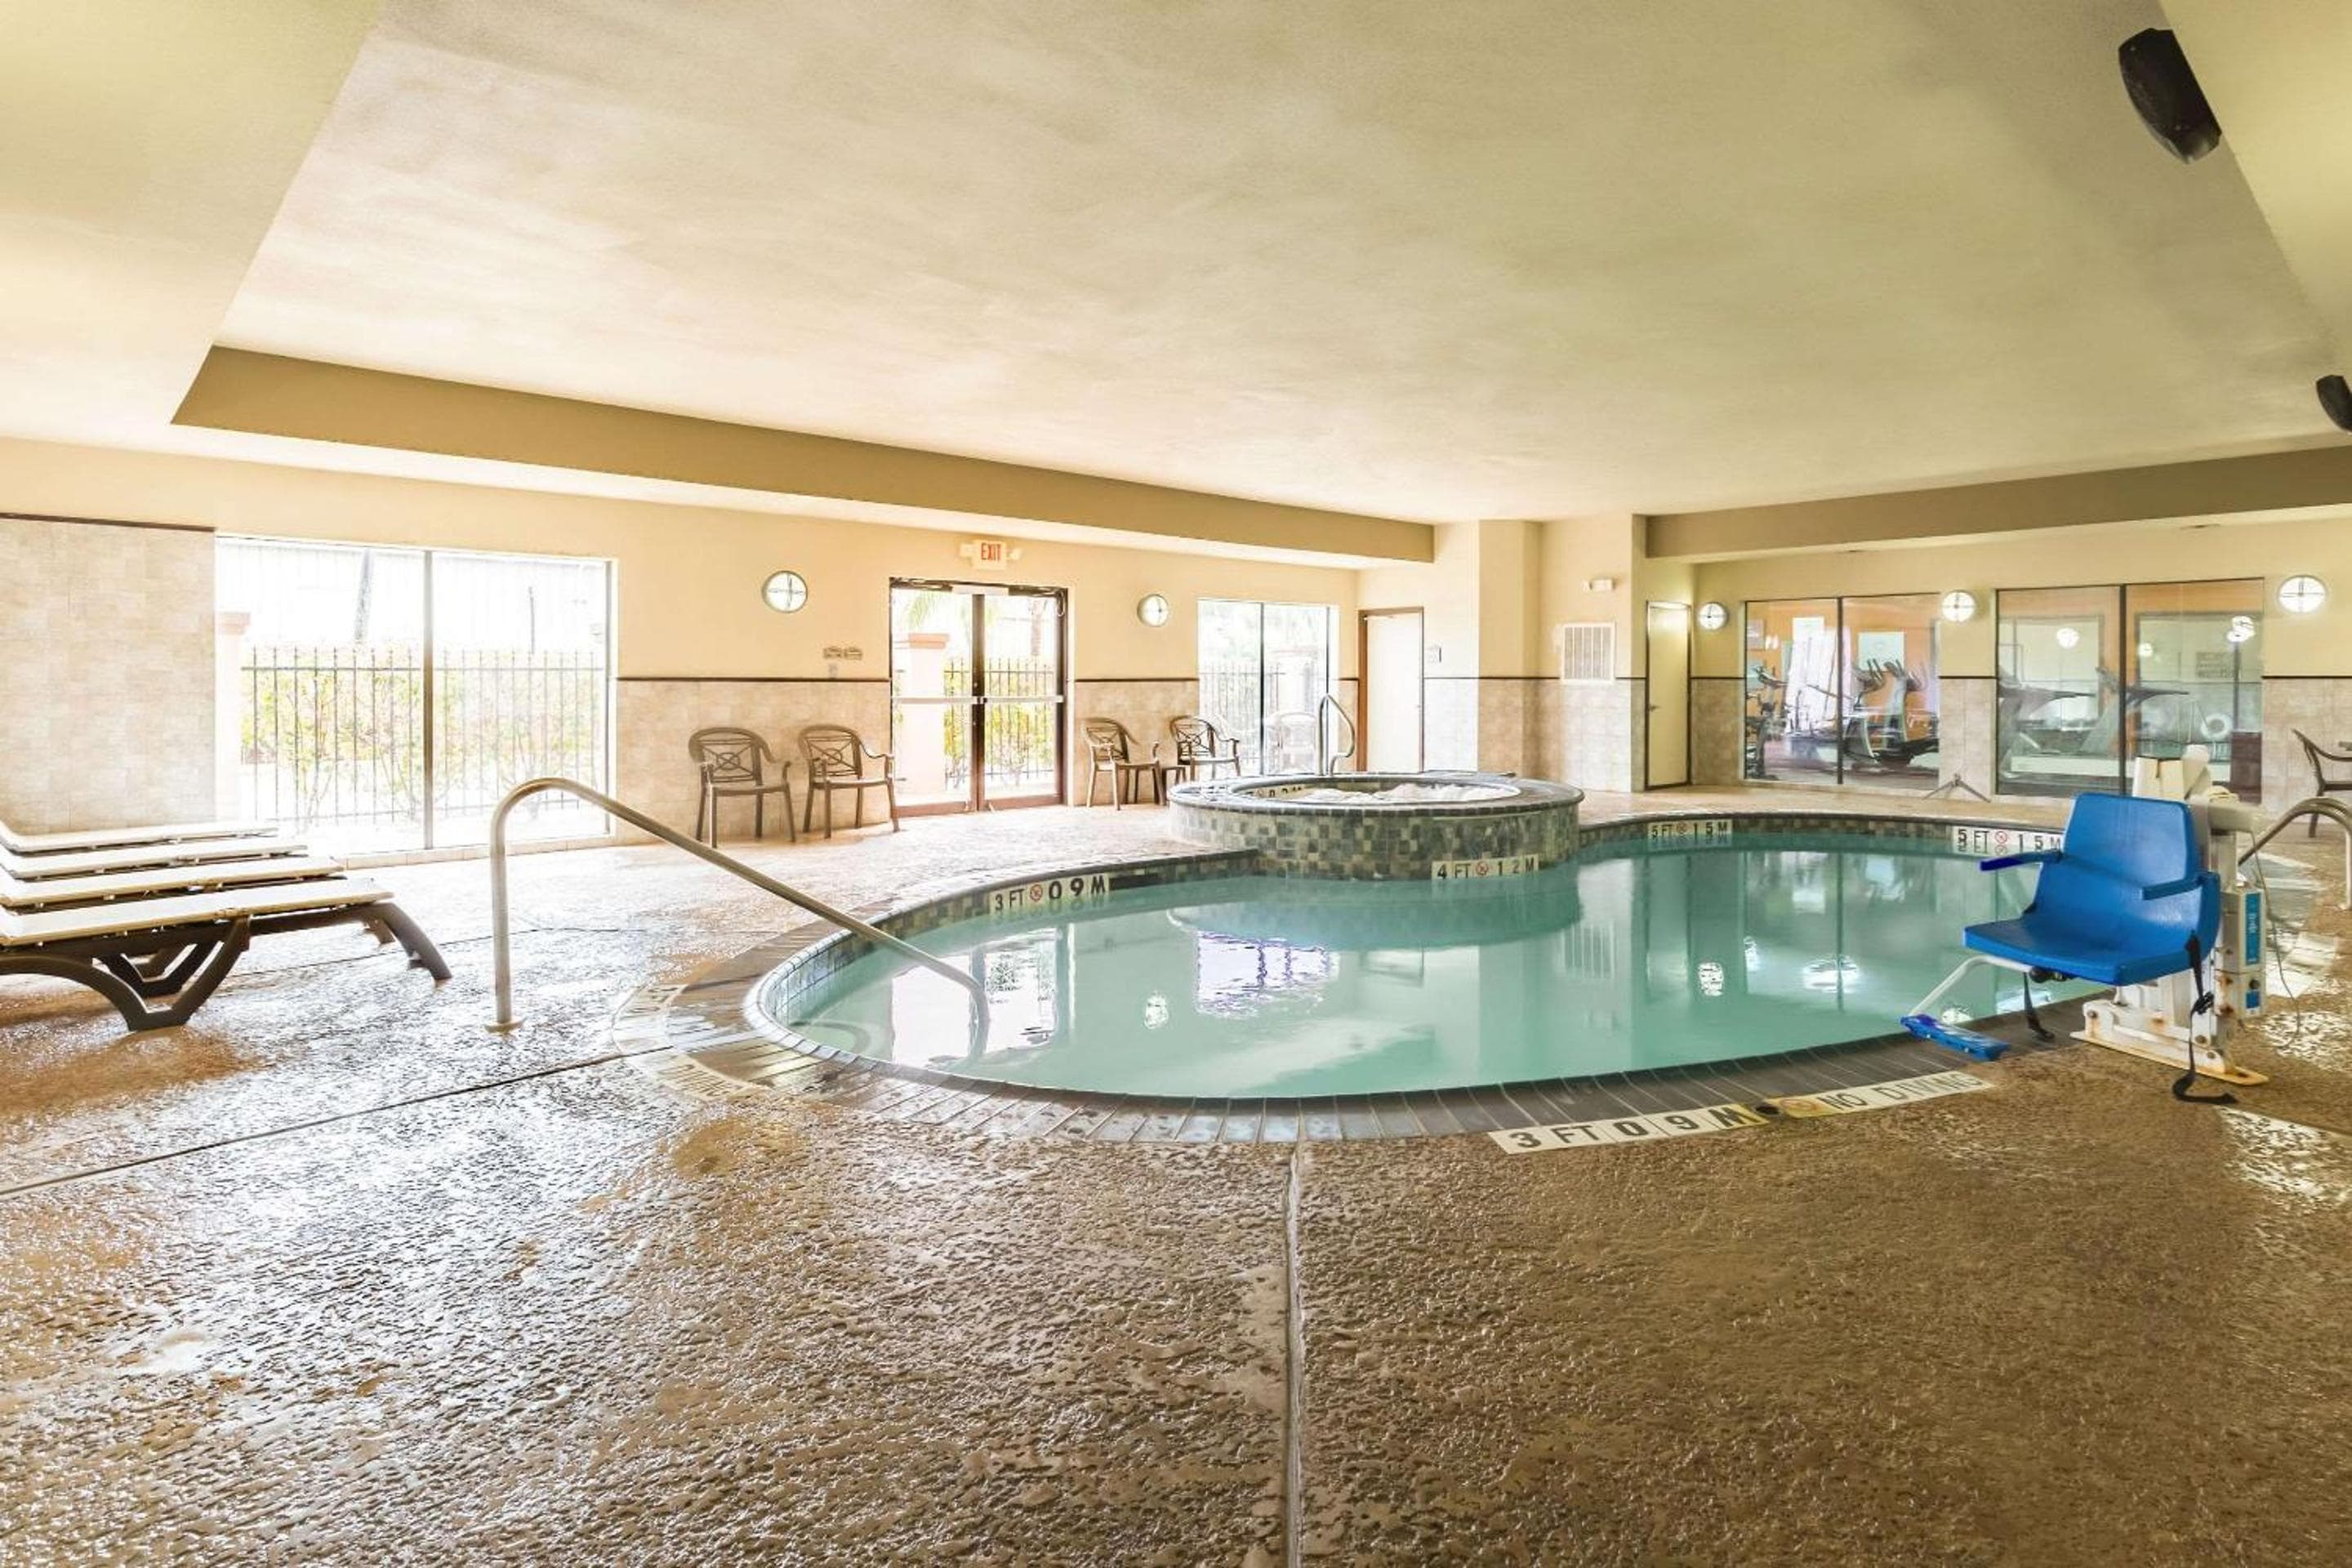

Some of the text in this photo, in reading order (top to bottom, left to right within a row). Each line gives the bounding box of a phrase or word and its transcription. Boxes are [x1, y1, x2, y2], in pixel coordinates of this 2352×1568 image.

[981, 542, 1002, 562] EXIT
[1437, 864, 1447, 880] 4
[1454, 862, 1471, 879] FT
[995, 893, 1004, 911] 3
[1009, 888, 1025, 909] FT
[1815, 1074, 1984, 1111] NO DIVING
[1509, 1131, 1543, 1149] 3
[1552, 1125, 1600, 1144] FT
